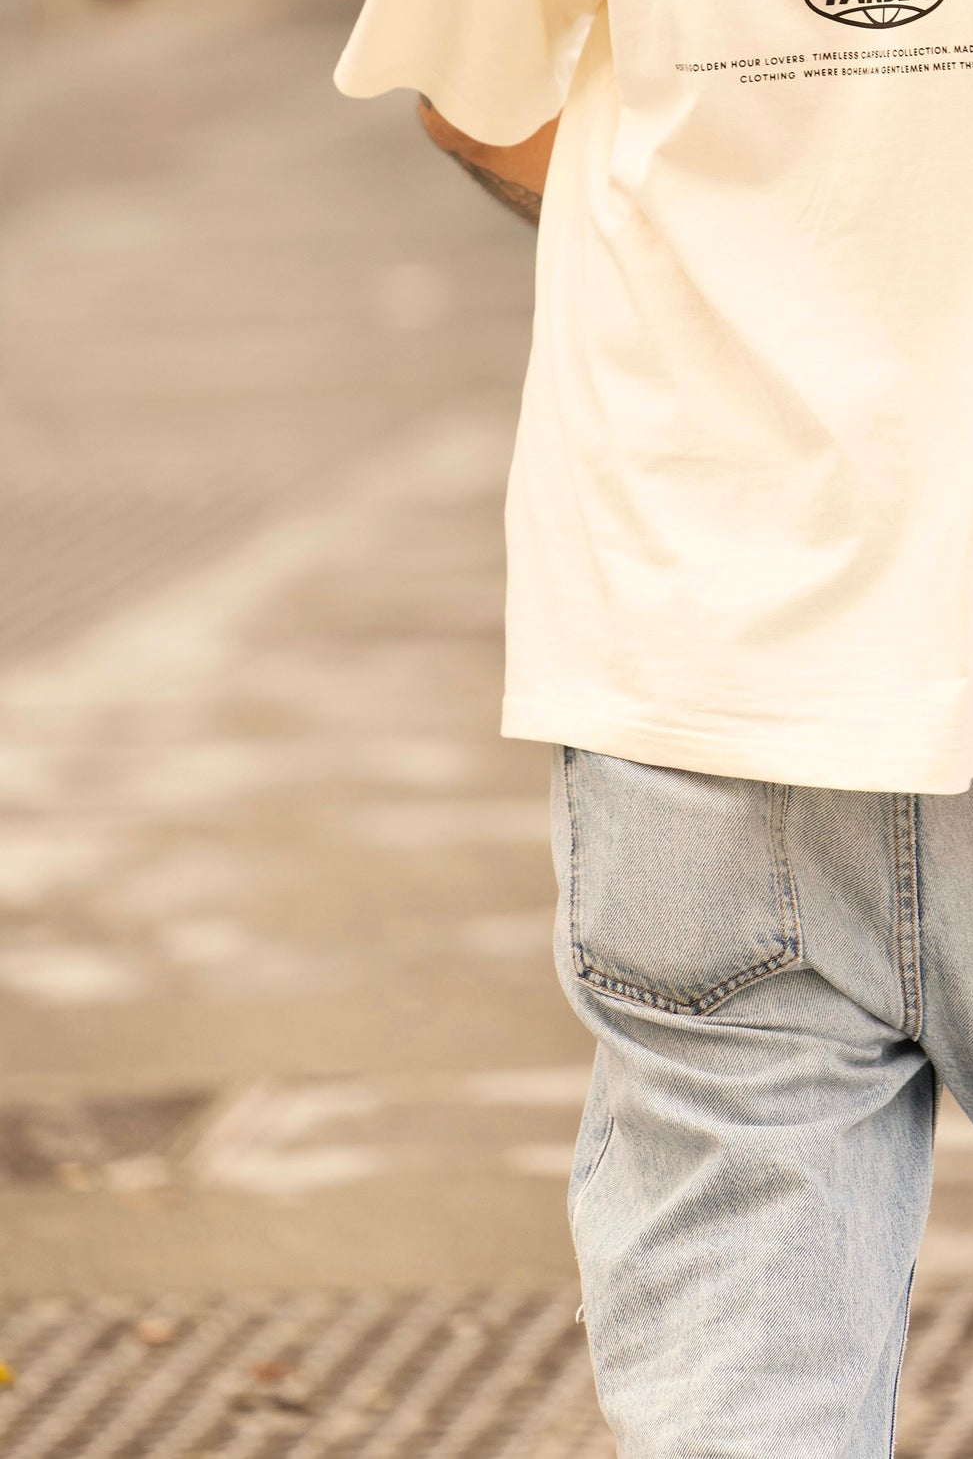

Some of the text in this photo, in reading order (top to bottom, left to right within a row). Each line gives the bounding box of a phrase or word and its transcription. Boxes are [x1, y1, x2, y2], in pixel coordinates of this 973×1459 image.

[689, 61, 727, 72] OLDEN
[731, 58, 761, 68] HOUR
[812, 51, 859, 61] TIMELESS
[861, 49, 890, 60] CAPSULE
[892, 46, 951, 58] COLLECTION.
[740, 71, 796, 83] CLOTHING
[803, 67, 838, 78] WHERE
[841, 66, 880, 76] BOHEMIAN
[881, 63, 930, 74] GENTLEMEN
[932, 61, 957, 71] MEET
